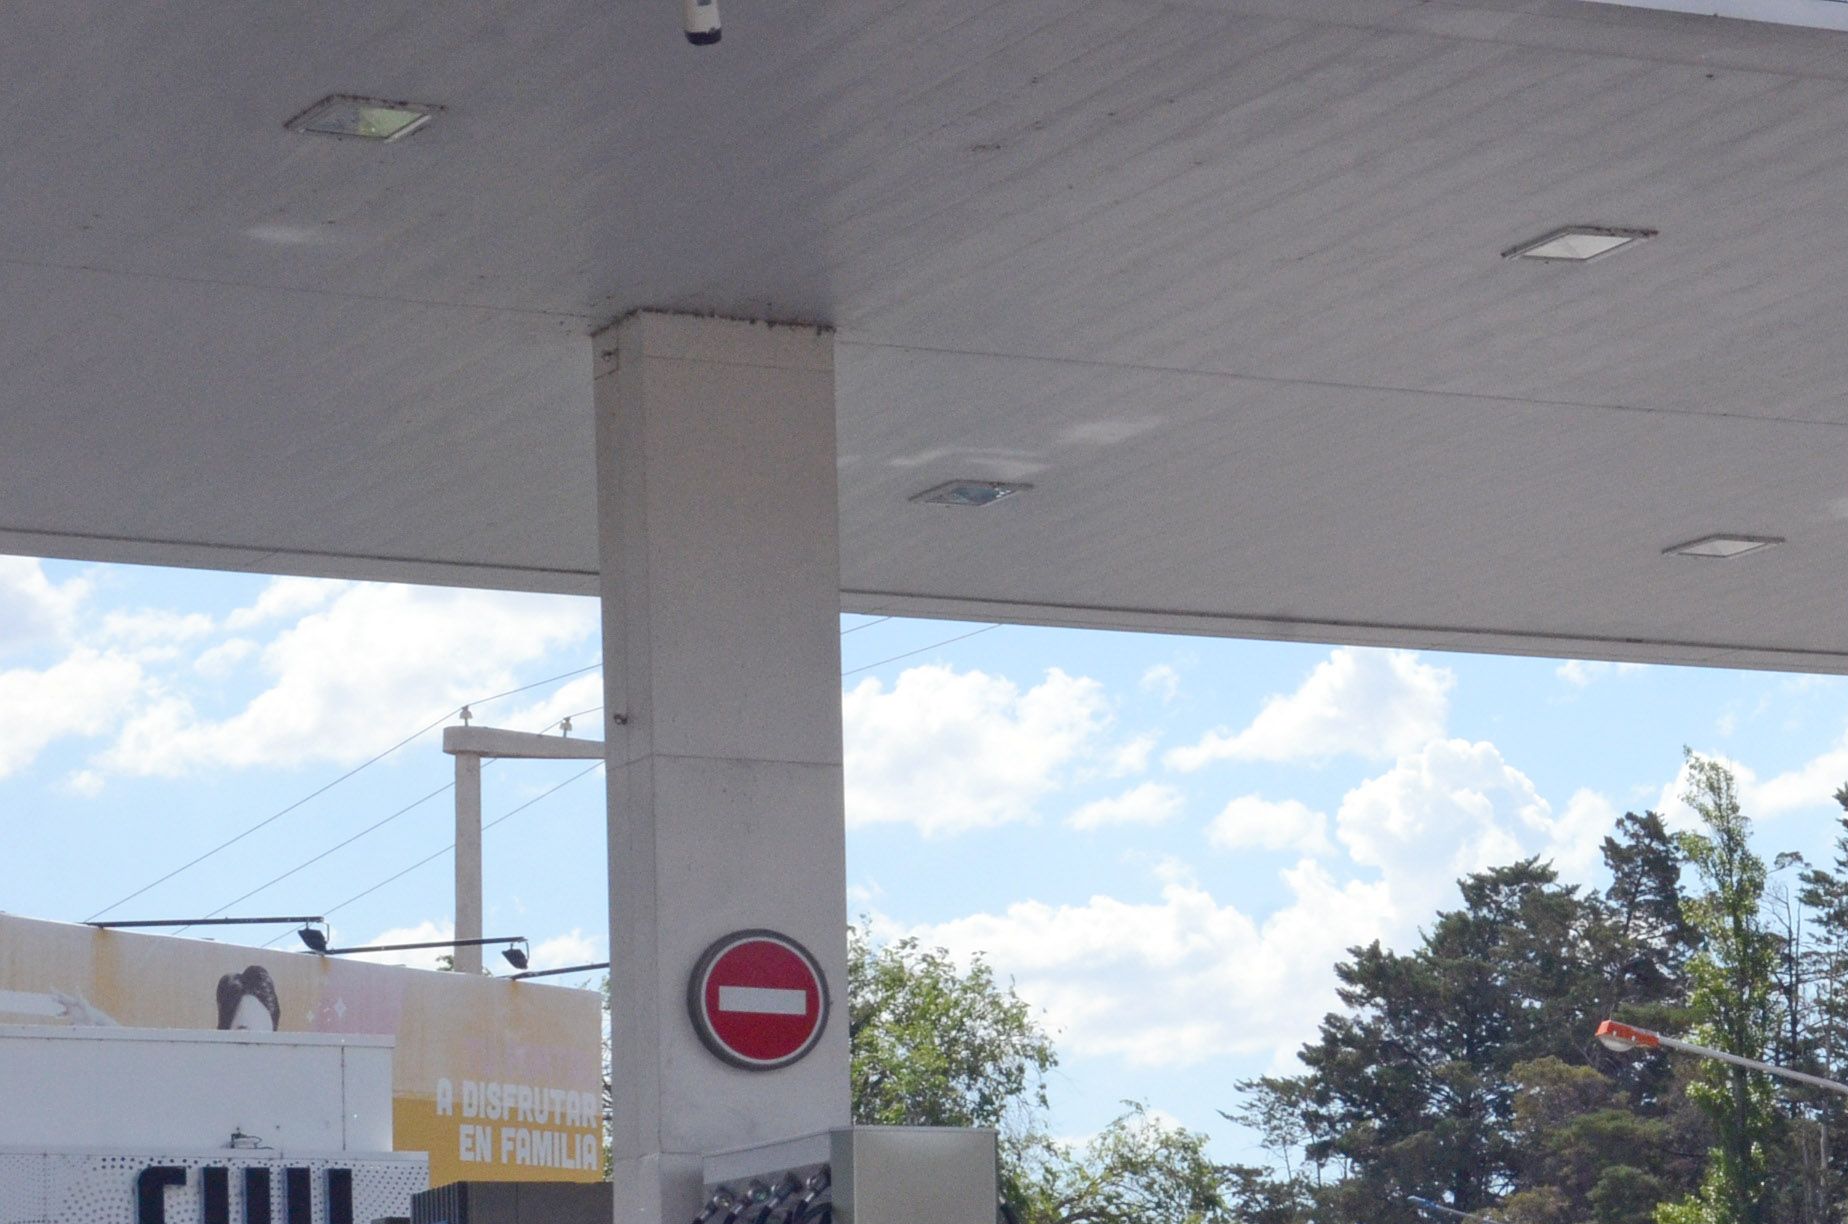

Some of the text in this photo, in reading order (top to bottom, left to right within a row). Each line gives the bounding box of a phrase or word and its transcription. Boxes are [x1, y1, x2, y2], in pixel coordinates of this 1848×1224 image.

[436, 1077, 598, 1129] A DISFRUTAR
[459, 1123, 598, 1171] EN FAMILIA
